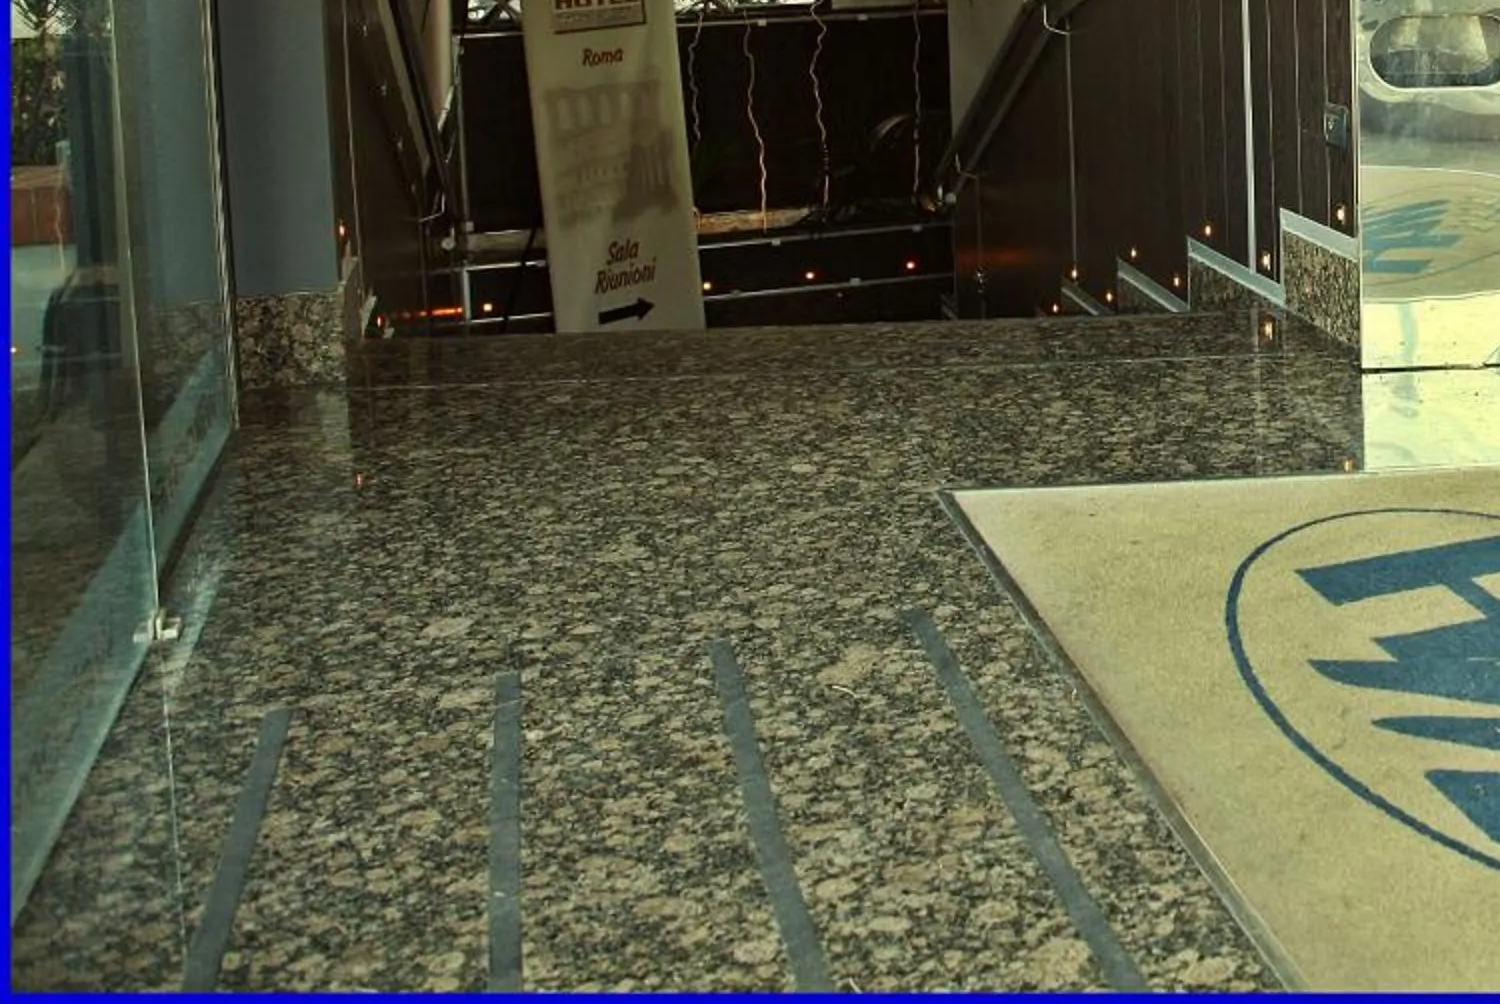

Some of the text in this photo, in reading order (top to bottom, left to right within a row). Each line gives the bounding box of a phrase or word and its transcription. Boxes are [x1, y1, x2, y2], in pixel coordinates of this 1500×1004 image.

[582, 48, 624, 67] Roma
[606, 239, 640, 265] Sala
[594, 257, 657, 294] Riunioni
